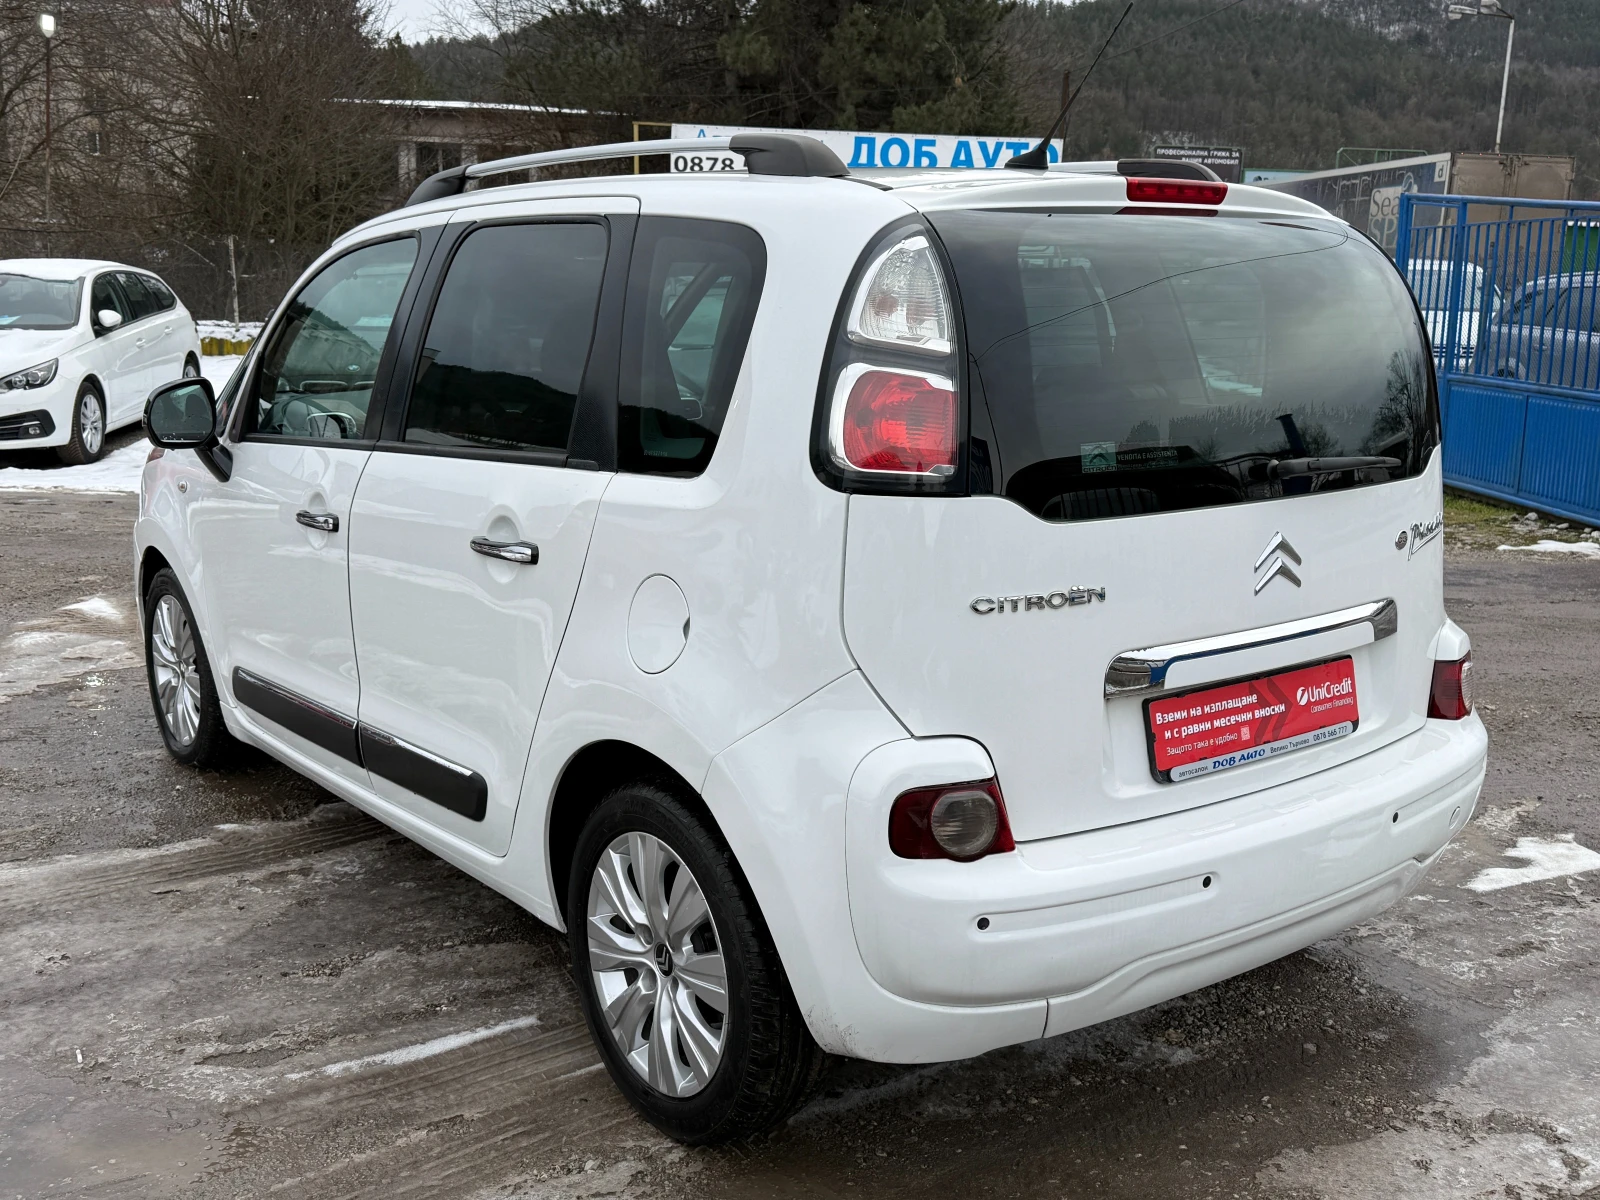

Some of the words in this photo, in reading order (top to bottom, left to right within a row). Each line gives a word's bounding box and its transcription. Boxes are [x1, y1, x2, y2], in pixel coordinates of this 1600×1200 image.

[674, 155, 734, 172] 0878
[847, 136, 938, 167] ДОБ
[1156, 148, 1208, 157] ПРОФЕСИОНАЛНА
[1147, 450, 1178, 458] ASSISTENZA
[969, 585, 1106, 615] CITROËN
[1309, 677, 1352, 702] UniCredit
[1156, 709, 1188, 725] Вземи
[1190, 706, 1202, 717] на
[1204, 694, 1258, 714] изплащане
[1310, 702, 1332, 713] Consumer
[1333, 697, 1353, 707] Financing
[1164, 730, 1171, 739] и
[1173, 727, 1179, 738] с
[1181, 721, 1211, 738] равни
[1213, 712, 1253, 728] месечни
[1254, 703, 1286, 719] вноски
[1166, 743, 1193, 756] Защото
[1194, 740, 1209, 750] така
[1209, 738, 1214, 746] е
[1215, 733, 1238, 746] удобно
[1178, 765, 1208, 777] автосалон
[1212, 756, 1236, 770] DOB
[1270, 744, 1289, 754] Велико
[1289, 738, 1310, 748] Търново
[1313, 733, 1327, 742] 0878
[1328, 728, 1338, 737] 565
[1338, 725, 1348, 734] 777
